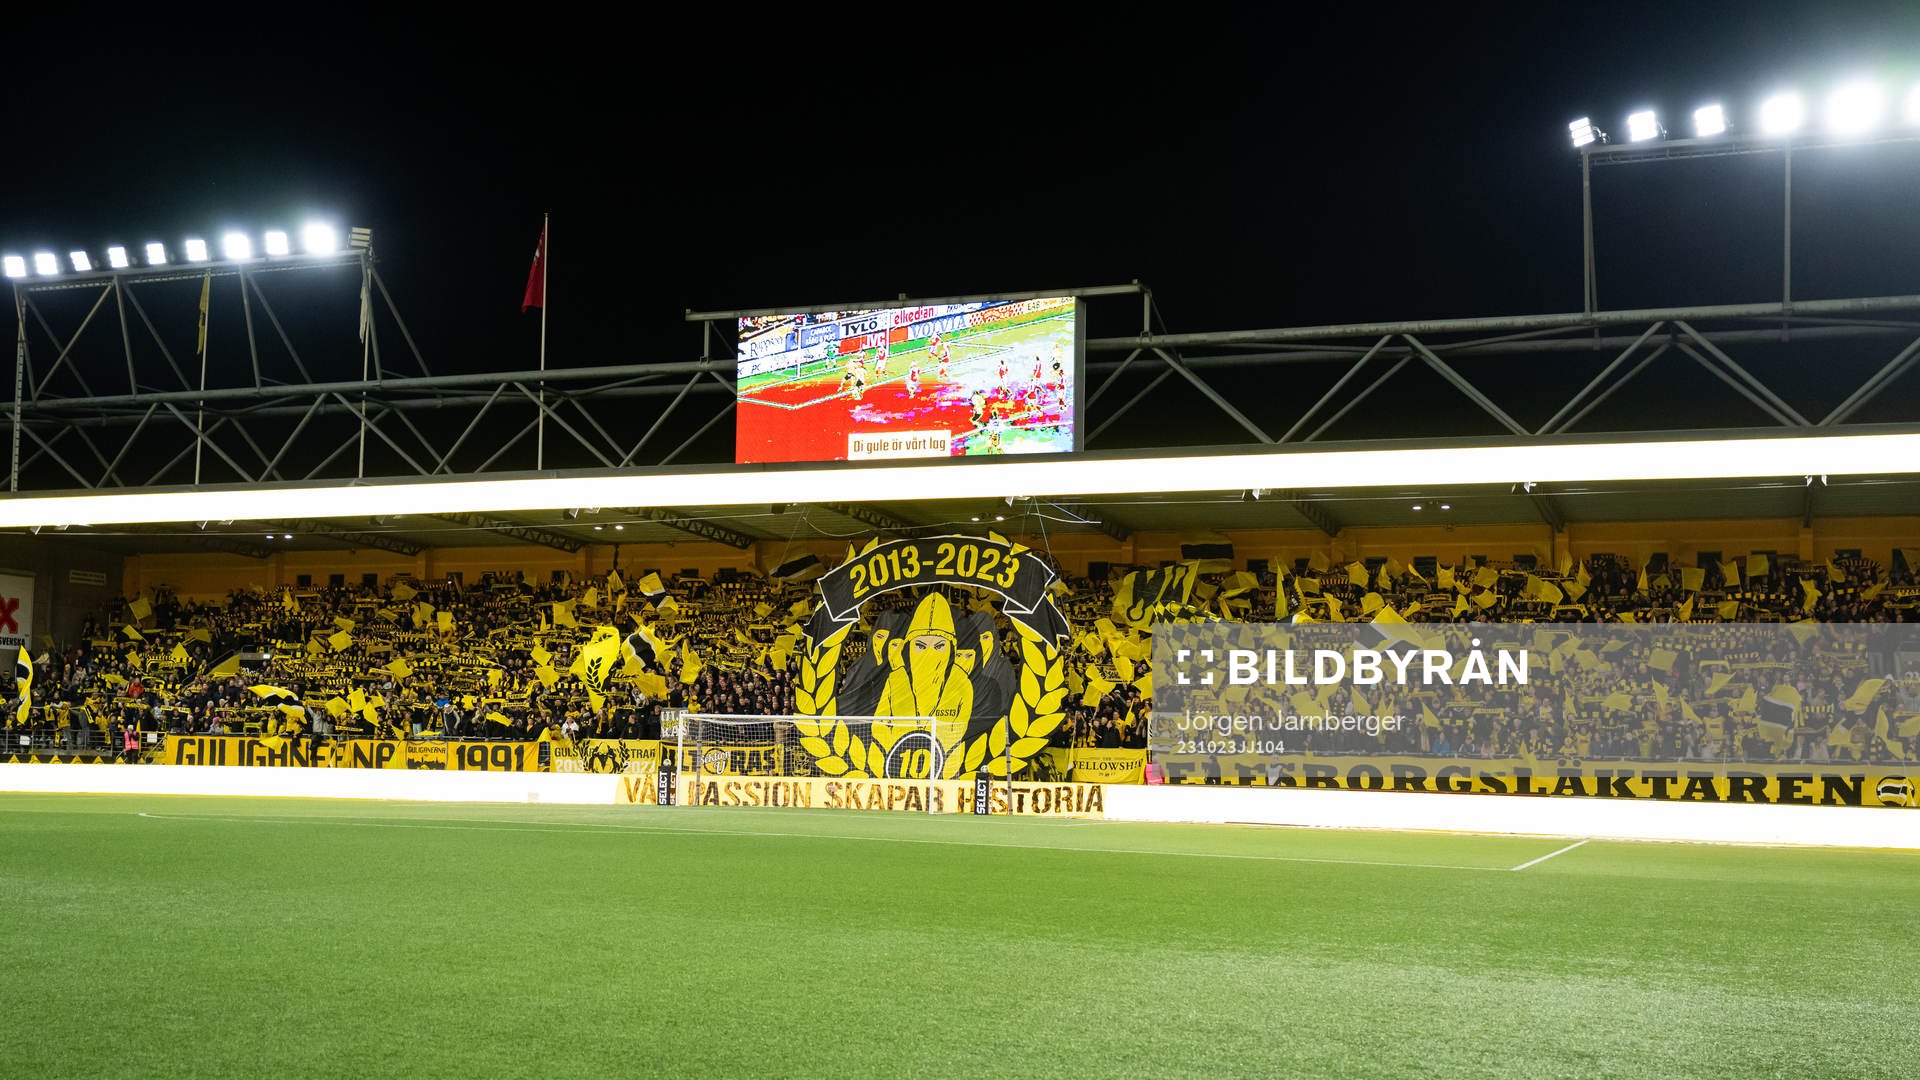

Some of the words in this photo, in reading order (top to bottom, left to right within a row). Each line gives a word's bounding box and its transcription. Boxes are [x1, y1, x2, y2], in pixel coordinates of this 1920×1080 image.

[842, 317, 878, 336] TYLÖ
[862, 332, 886, 349] JVC
[853, 440, 864, 453] Di
[866, 439, 889, 455] gule
[892, 438, 903, 451] är
[905, 437, 926, 451] vårt
[929, 437, 946, 451] lag
[850, 543, 1020, 599] 2013-2023
[456, 745, 524, 771] 1991
[900, 749, 931, 779] 10
[624, 773, 657, 803] VÅ
[688, 781, 812, 807] PASSION
[824, 781, 944, 813] SKAPAR
[958, 785, 1104, 814] HSTORIA
[659, 771, 668, 805] SELECT
[976, 779, 987, 814] SELECT
